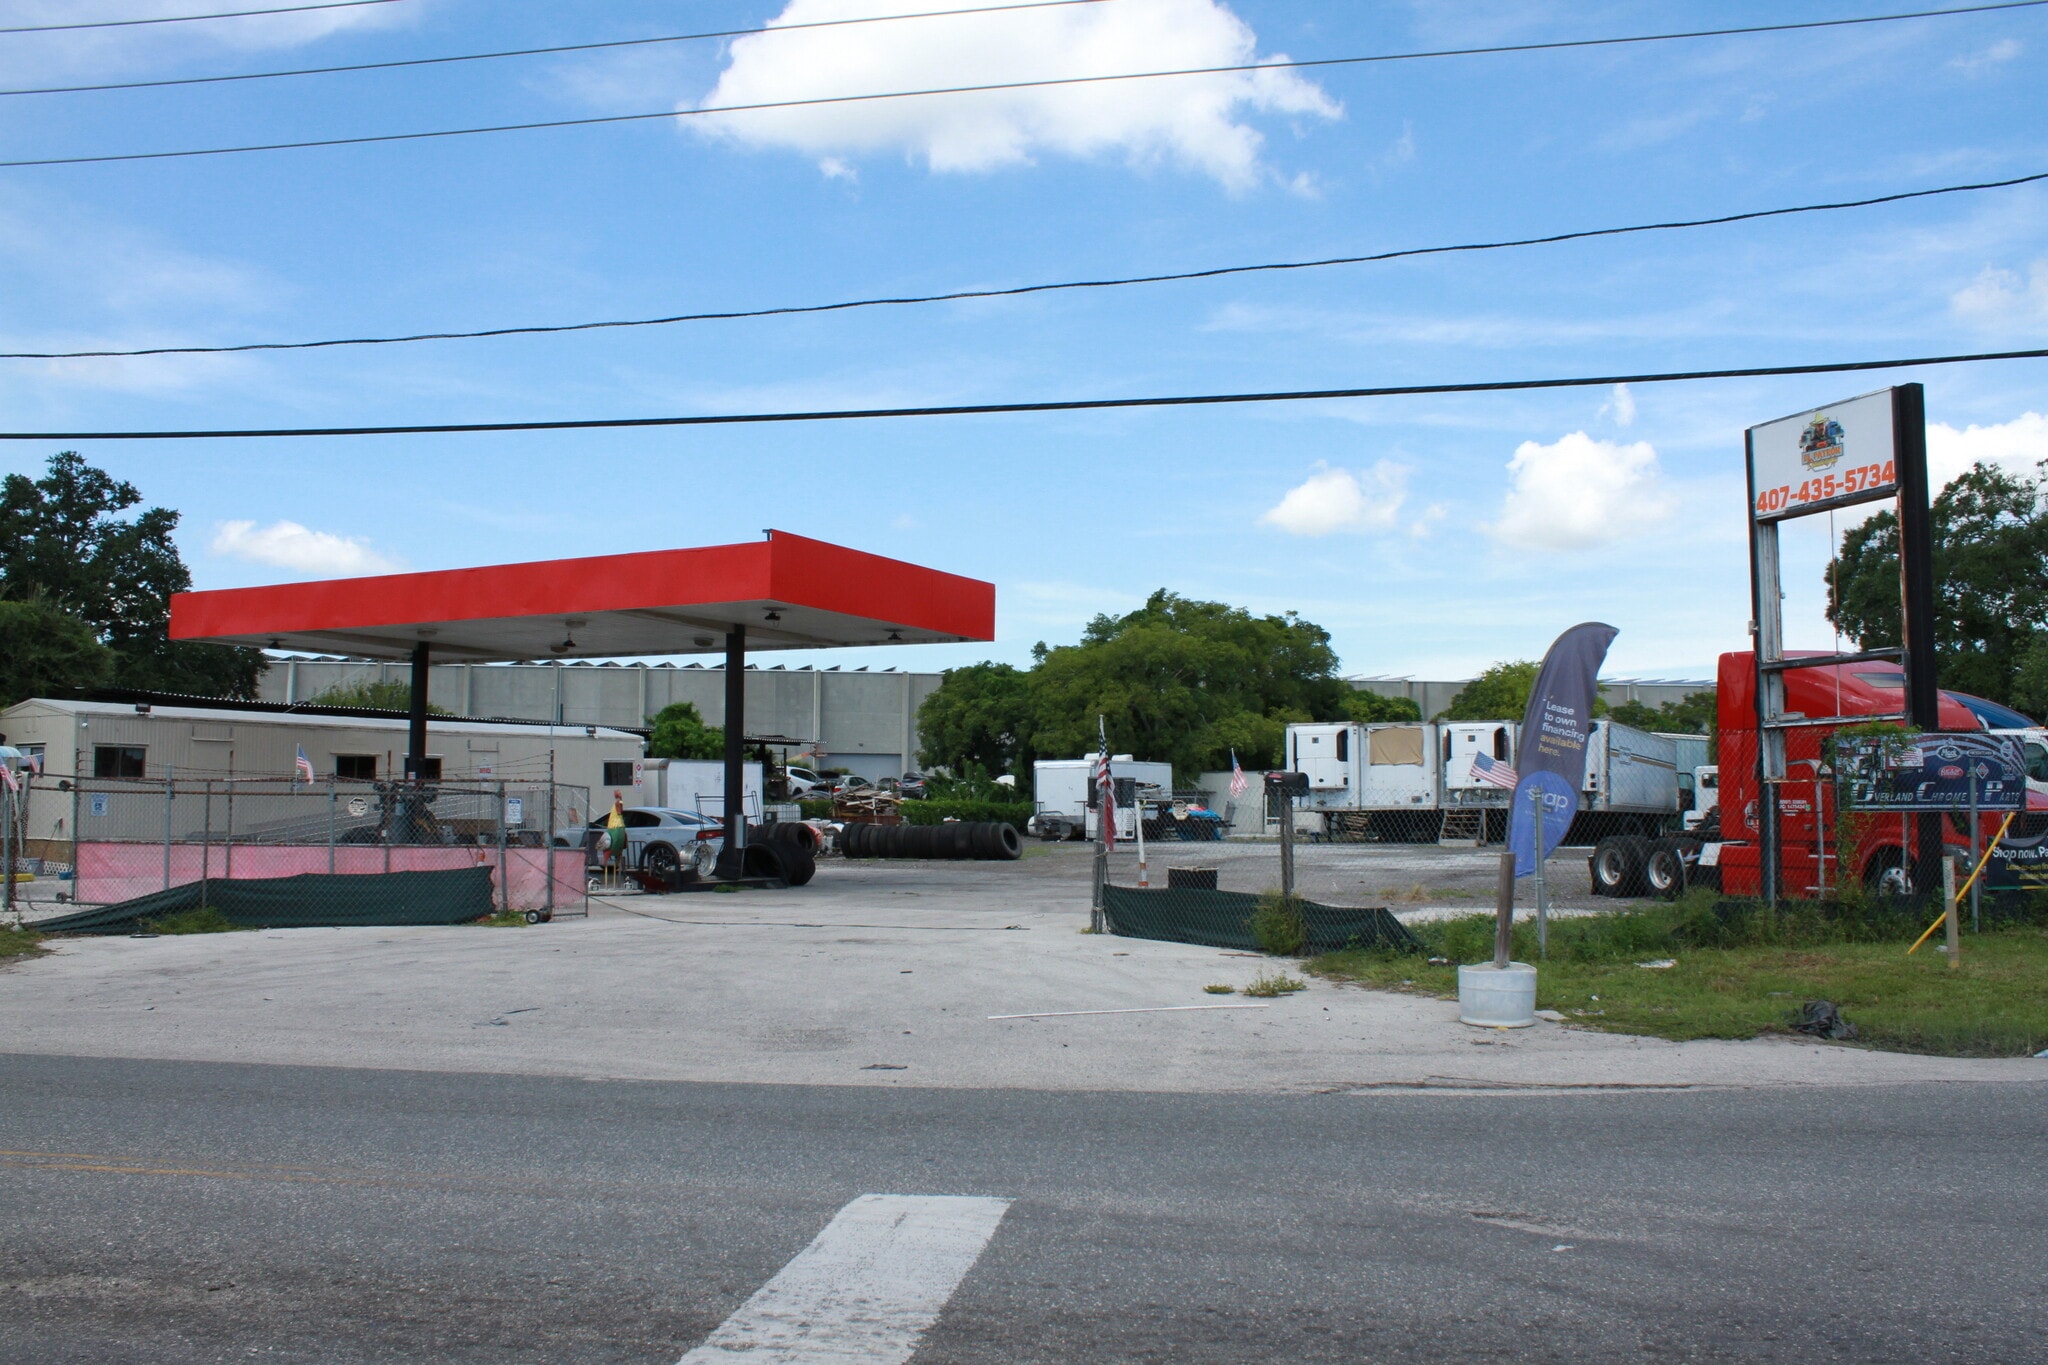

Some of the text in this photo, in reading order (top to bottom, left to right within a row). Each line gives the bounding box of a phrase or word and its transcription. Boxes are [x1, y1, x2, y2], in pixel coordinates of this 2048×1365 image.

[1757, 460, 1895, 512] 407-435-5734
[1546, 701, 1574, 715] Lease
[1544, 712, 1577, 726] to own
[1542, 723, 1585, 742] financing
[1540, 735, 1582, 750] available
[1851, 779, 1914, 802] OVERLAND
[1916, 781, 1967, 802] CHROME
[1984, 780, 2020, 802] PARTS
[2018, 849, 2038, 859] now.
